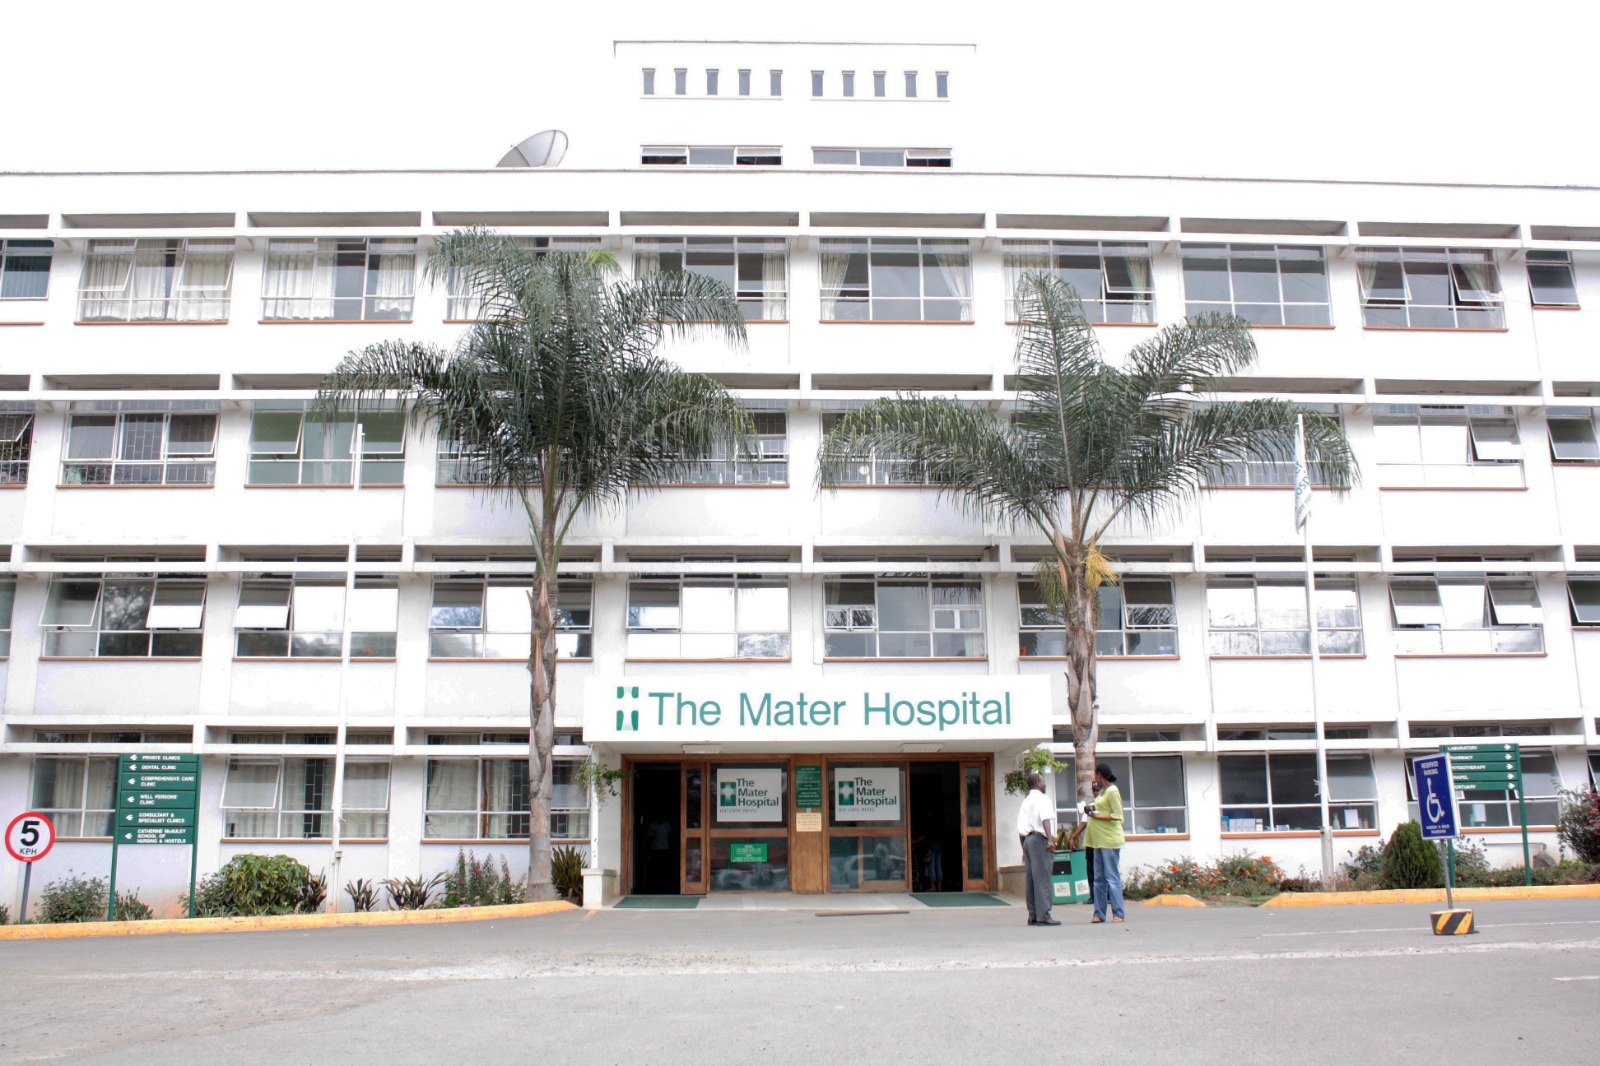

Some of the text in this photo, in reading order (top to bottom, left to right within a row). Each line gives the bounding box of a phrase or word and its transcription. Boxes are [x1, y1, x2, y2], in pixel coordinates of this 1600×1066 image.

[648, 691, 1011, 731] The Mater Hospital
[736, 778, 754, 787] The
[854, 777, 872, 786] The
[738, 788, 768, 797] Mater
[856, 787, 886, 796] Mater
[738, 797, 779, 808] Hospital
[856, 796, 897, 807] Hospital
[20, 820, 40, 846] 5
